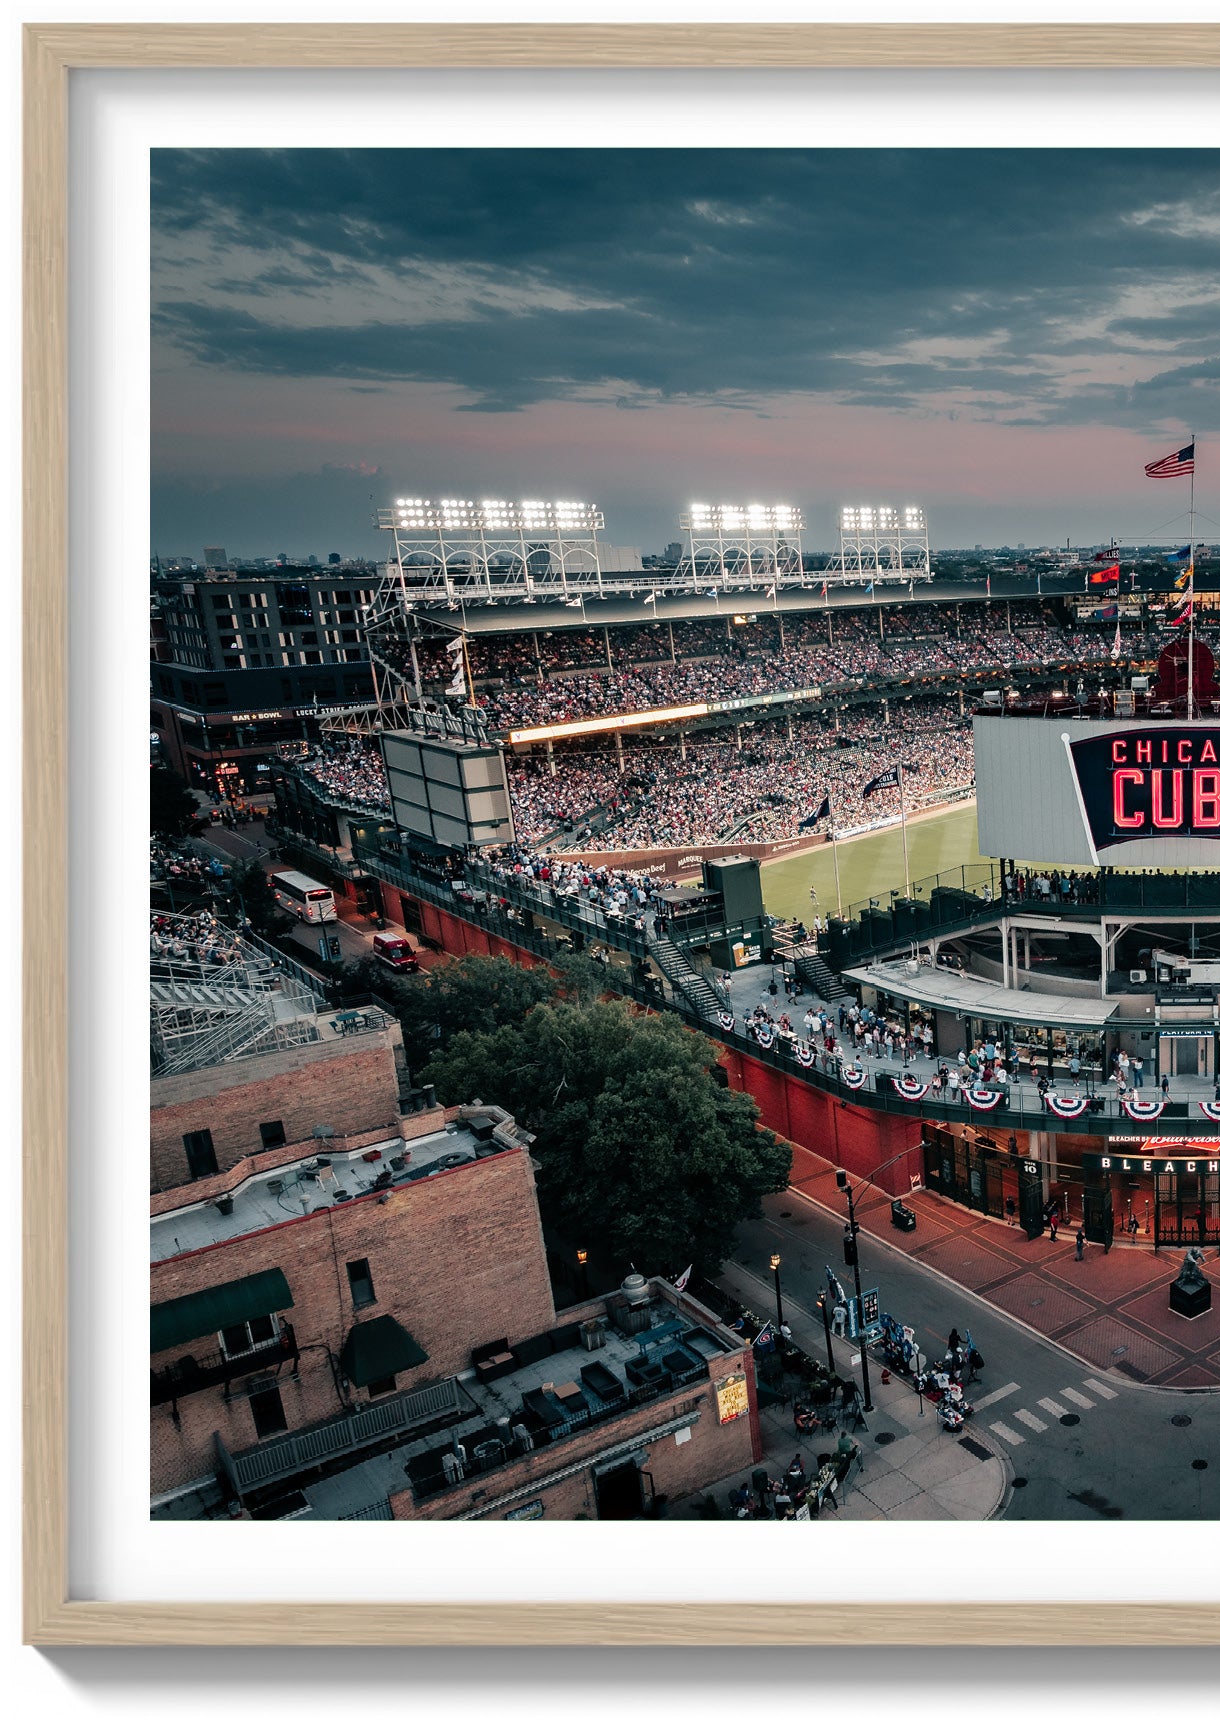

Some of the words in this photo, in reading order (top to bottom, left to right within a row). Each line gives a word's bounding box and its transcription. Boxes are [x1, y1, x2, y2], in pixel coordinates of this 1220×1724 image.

[258, 711, 282, 719] BOWL
[678, 856, 703, 867] MARQUEE
[650, 863, 666, 873] Beef
[1024, 1165, 1037, 1173] 10
